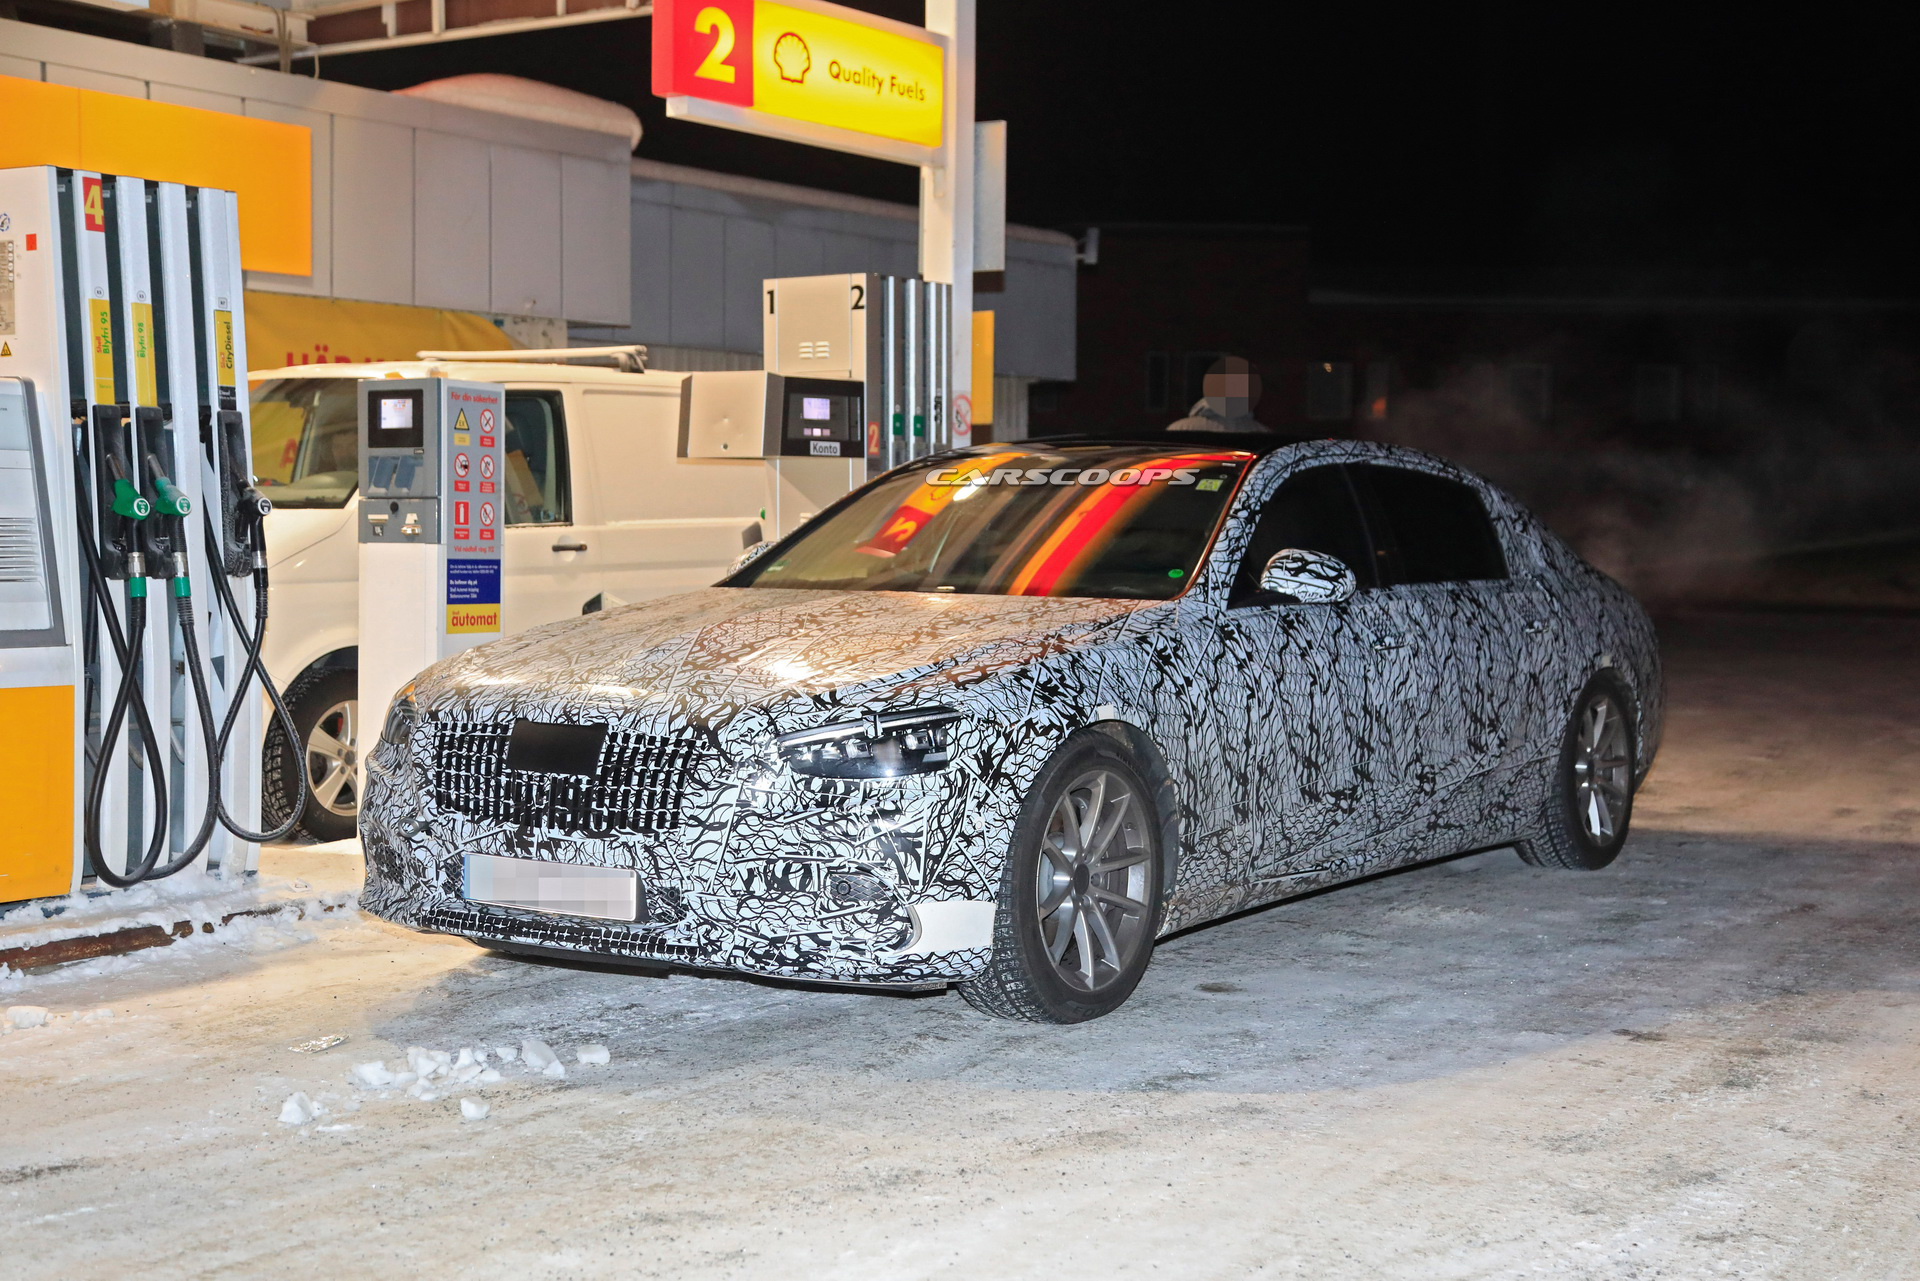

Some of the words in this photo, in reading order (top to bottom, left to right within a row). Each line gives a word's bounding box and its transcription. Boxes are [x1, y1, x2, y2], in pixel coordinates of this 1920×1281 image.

[695, 6, 735, 84] 2
[829, 60, 884, 95] Quality
[890, 76, 925, 101] Fuels
[85, 184, 104, 225] 4
[767, 289, 774, 314] 1
[851, 285, 865, 310] 2
[100, 311, 108, 324] 95
[138, 322, 144, 333] 98
[101, 327, 112, 354] Blyfri
[138, 335, 146, 358] Blyfri
[224, 321, 233, 369] CityDiesel
[812, 443, 838, 454] Konto
[869, 424, 879, 453] 2
[451, 612, 497, 627] automat
